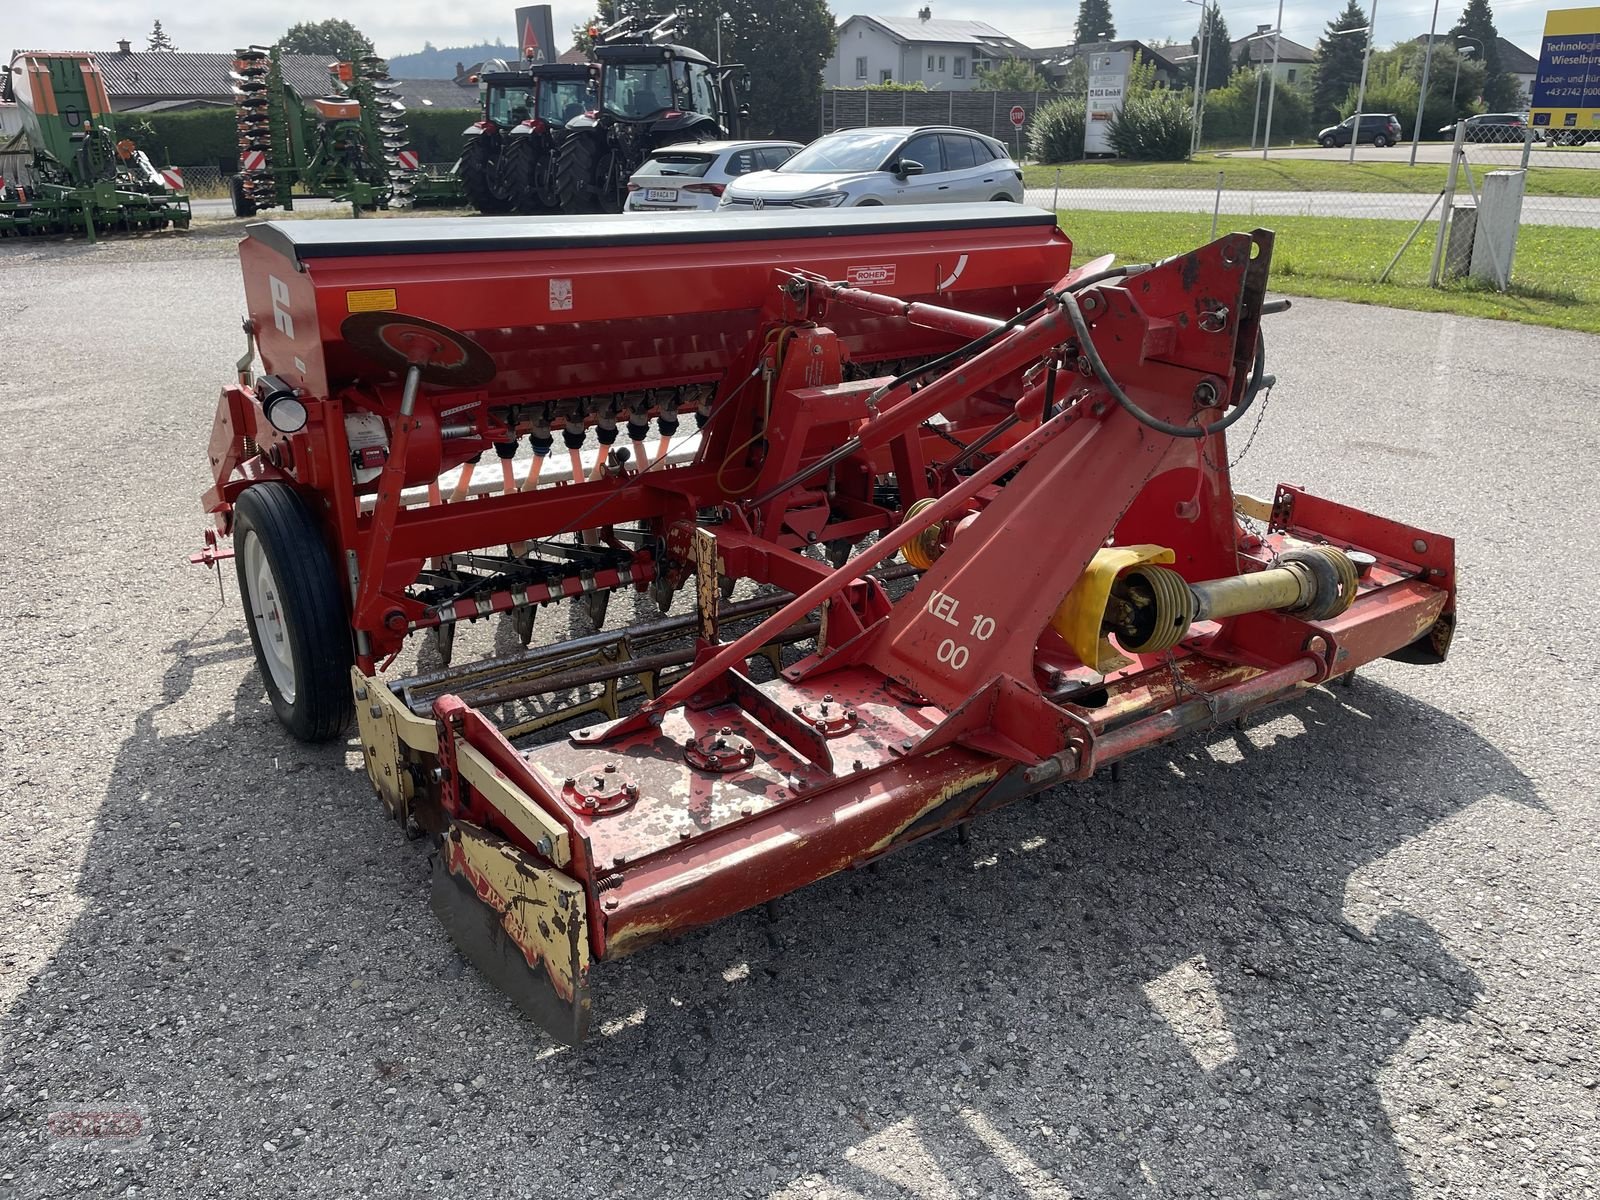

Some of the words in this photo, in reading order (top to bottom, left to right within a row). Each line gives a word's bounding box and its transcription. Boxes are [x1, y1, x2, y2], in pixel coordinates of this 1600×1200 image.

[521, 48, 545, 62] AA
[1567, 74, 1584, 83] und
[1104, 88, 1121, 97] GmbH
[1562, 87, 1581, 96] 2742
[1012, 112, 1023, 120] STOP
[969, 614, 997, 641] 10
[936, 638, 970, 670] 00
